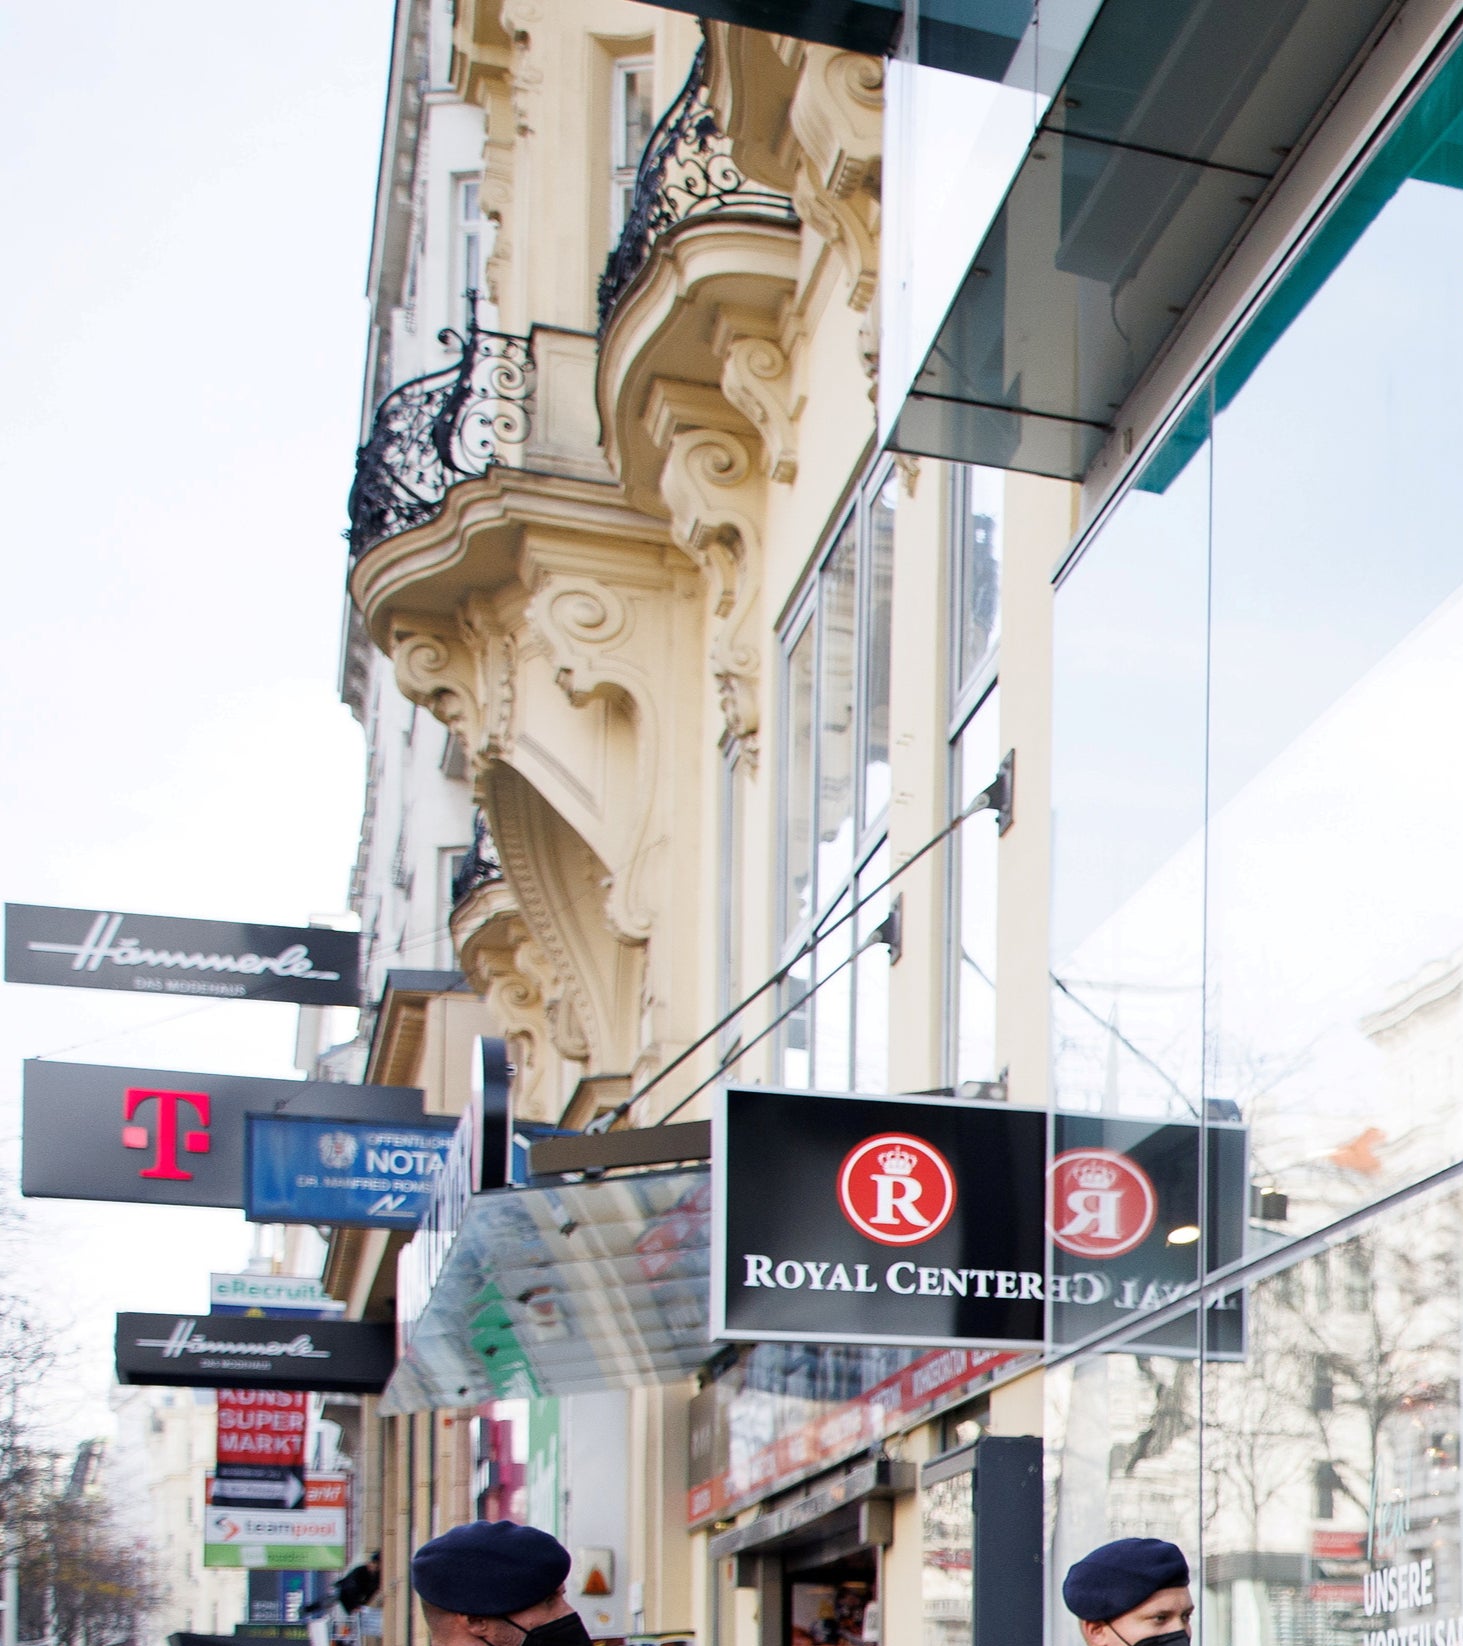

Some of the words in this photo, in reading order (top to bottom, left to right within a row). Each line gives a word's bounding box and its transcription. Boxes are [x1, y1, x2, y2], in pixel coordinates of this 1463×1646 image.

[28, 911, 340, 981] Hämmerle
[122, 1088, 211, 1180] T
[367, 1149, 445, 1175] NOTA
[869, 1173, 932, 1228] R
[218, 1408, 304, 1432] SUPER
[1363, 1557, 1433, 1617] UNSERE
